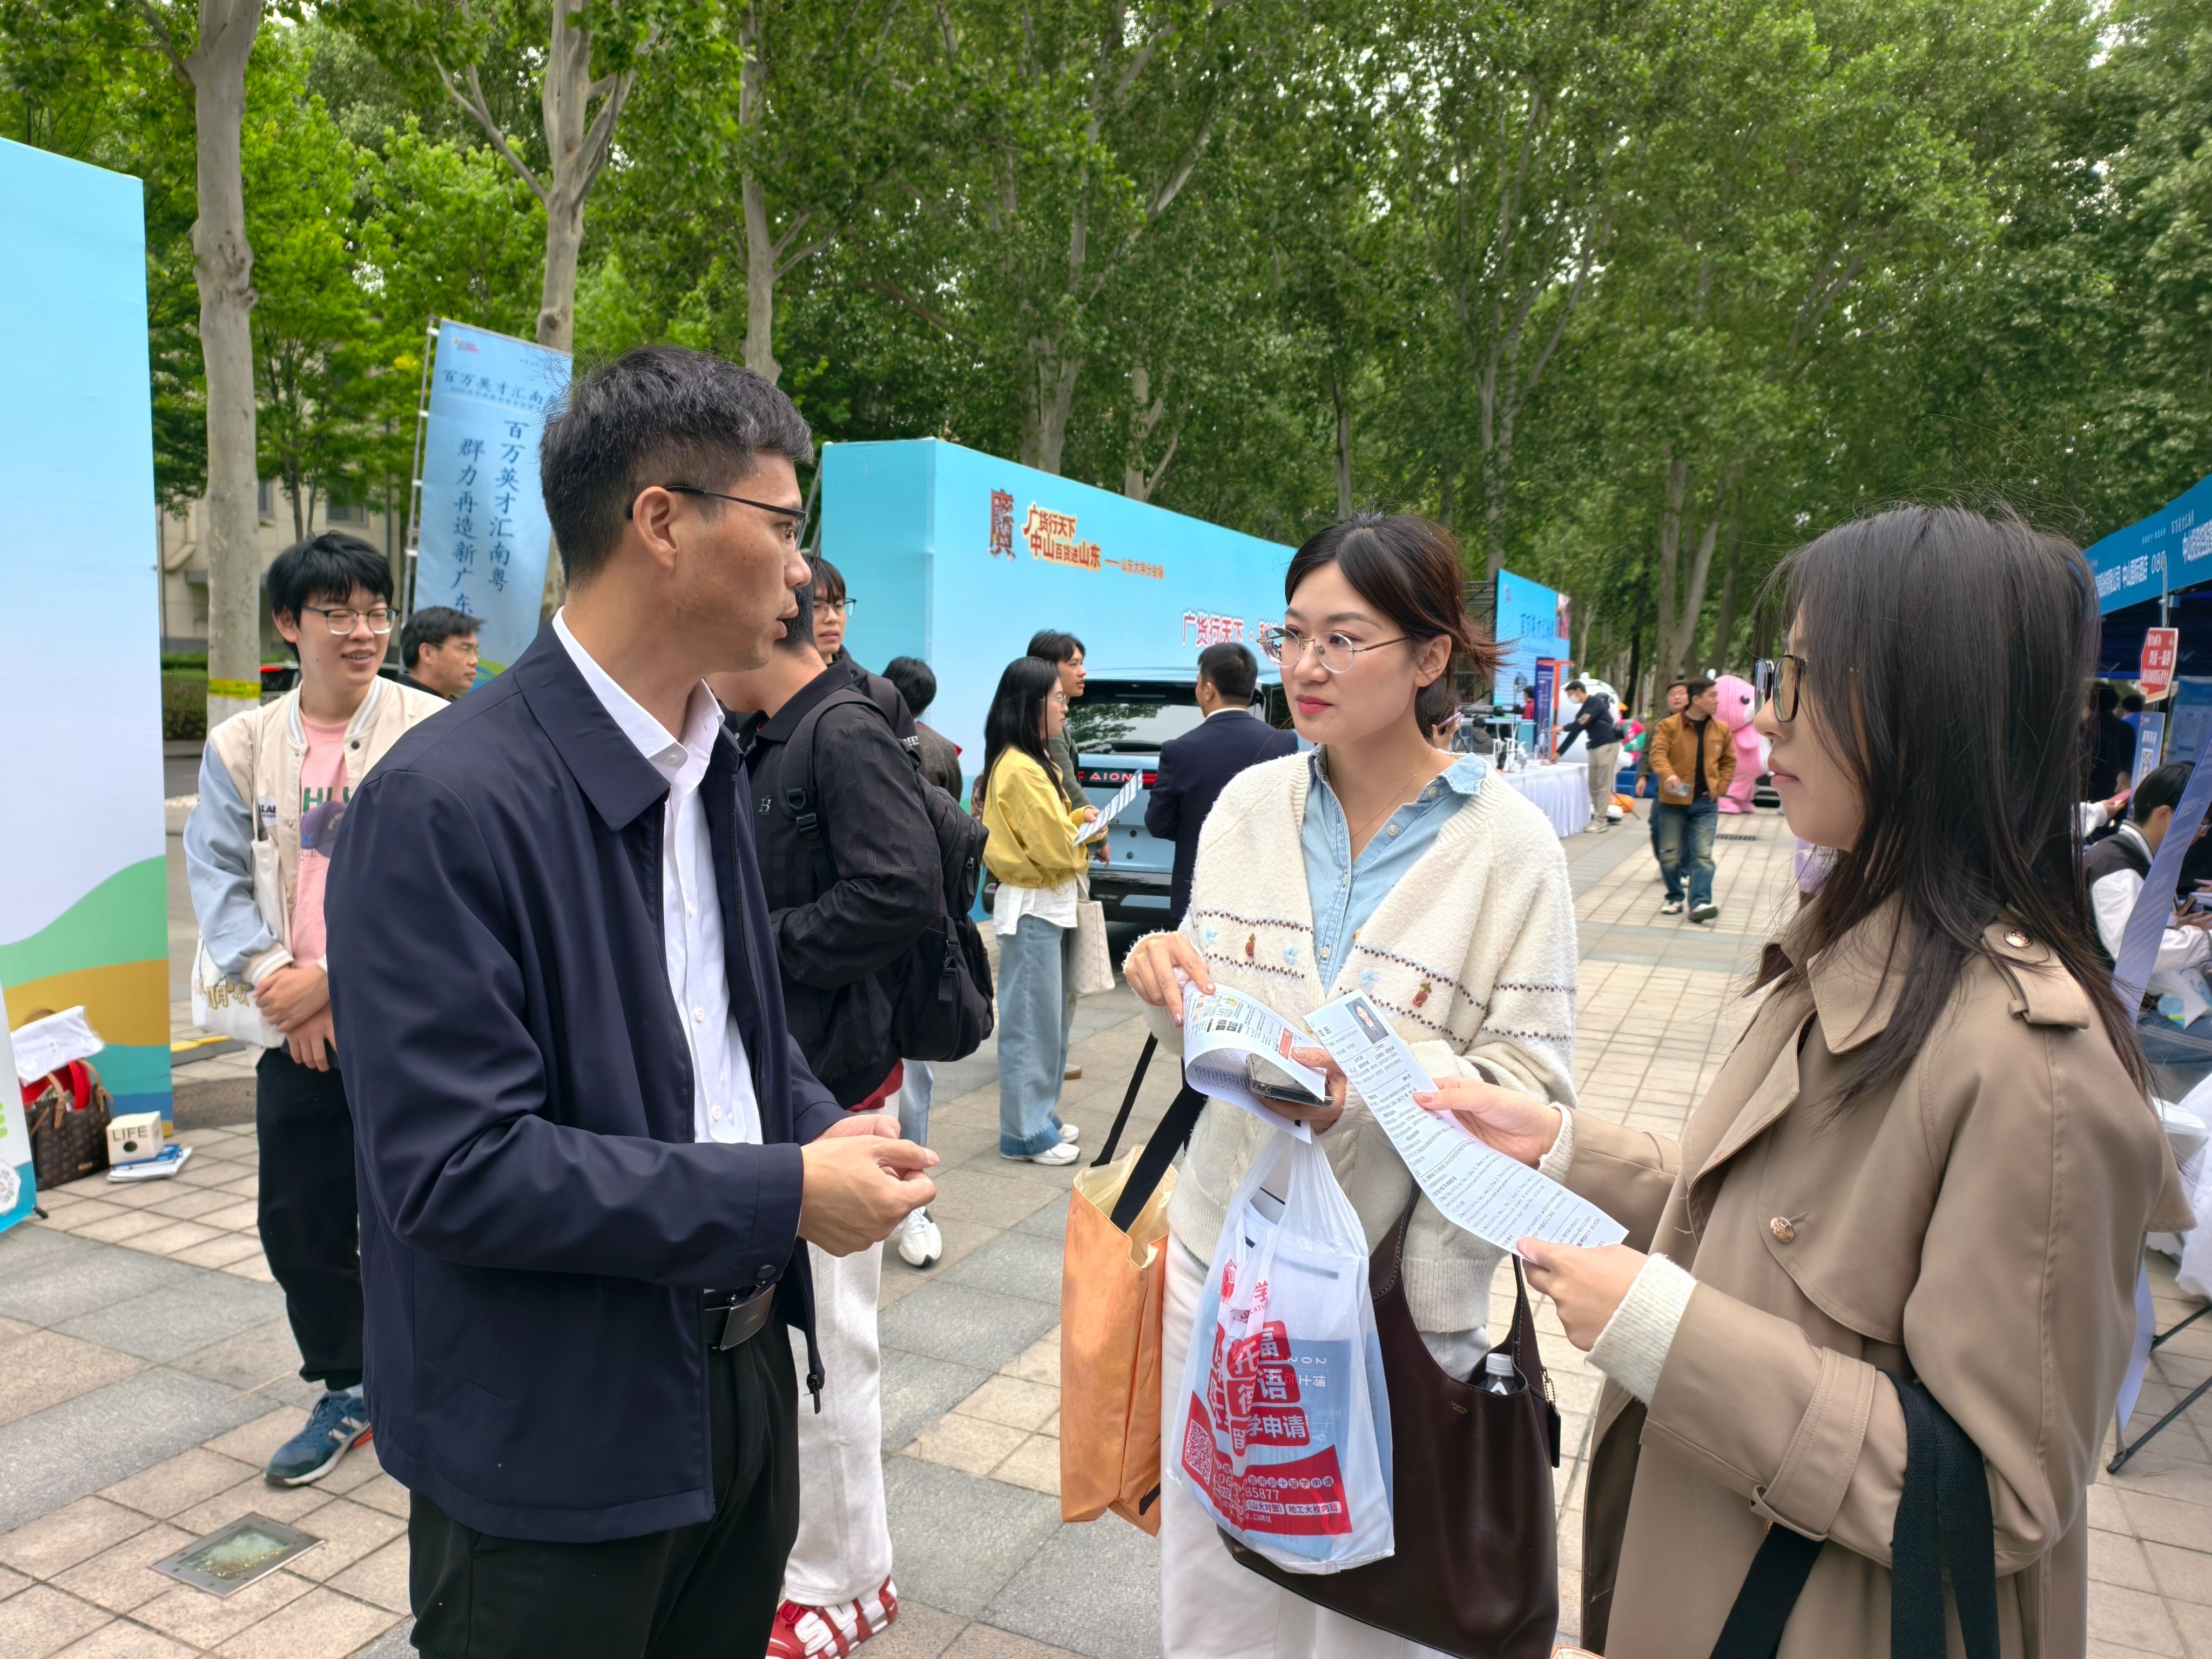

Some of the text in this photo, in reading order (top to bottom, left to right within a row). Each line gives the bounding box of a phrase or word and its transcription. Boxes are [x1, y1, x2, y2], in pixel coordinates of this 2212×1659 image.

[487, 419, 529, 594] 百万英才汇南粤
[1023, 503, 1076, 538] 广货行天下
[449, 438, 485, 616] 群力再造新广东
[1030, 531, 1101, 568] 中山百货进山东
[1182, 611, 1244, 648] 广货行天下
[1089, 772, 1134, 781] AION
[112, 1125, 148, 1142] LIFE
[1289, 1503, 1338, 1514] 哈工大校内班
